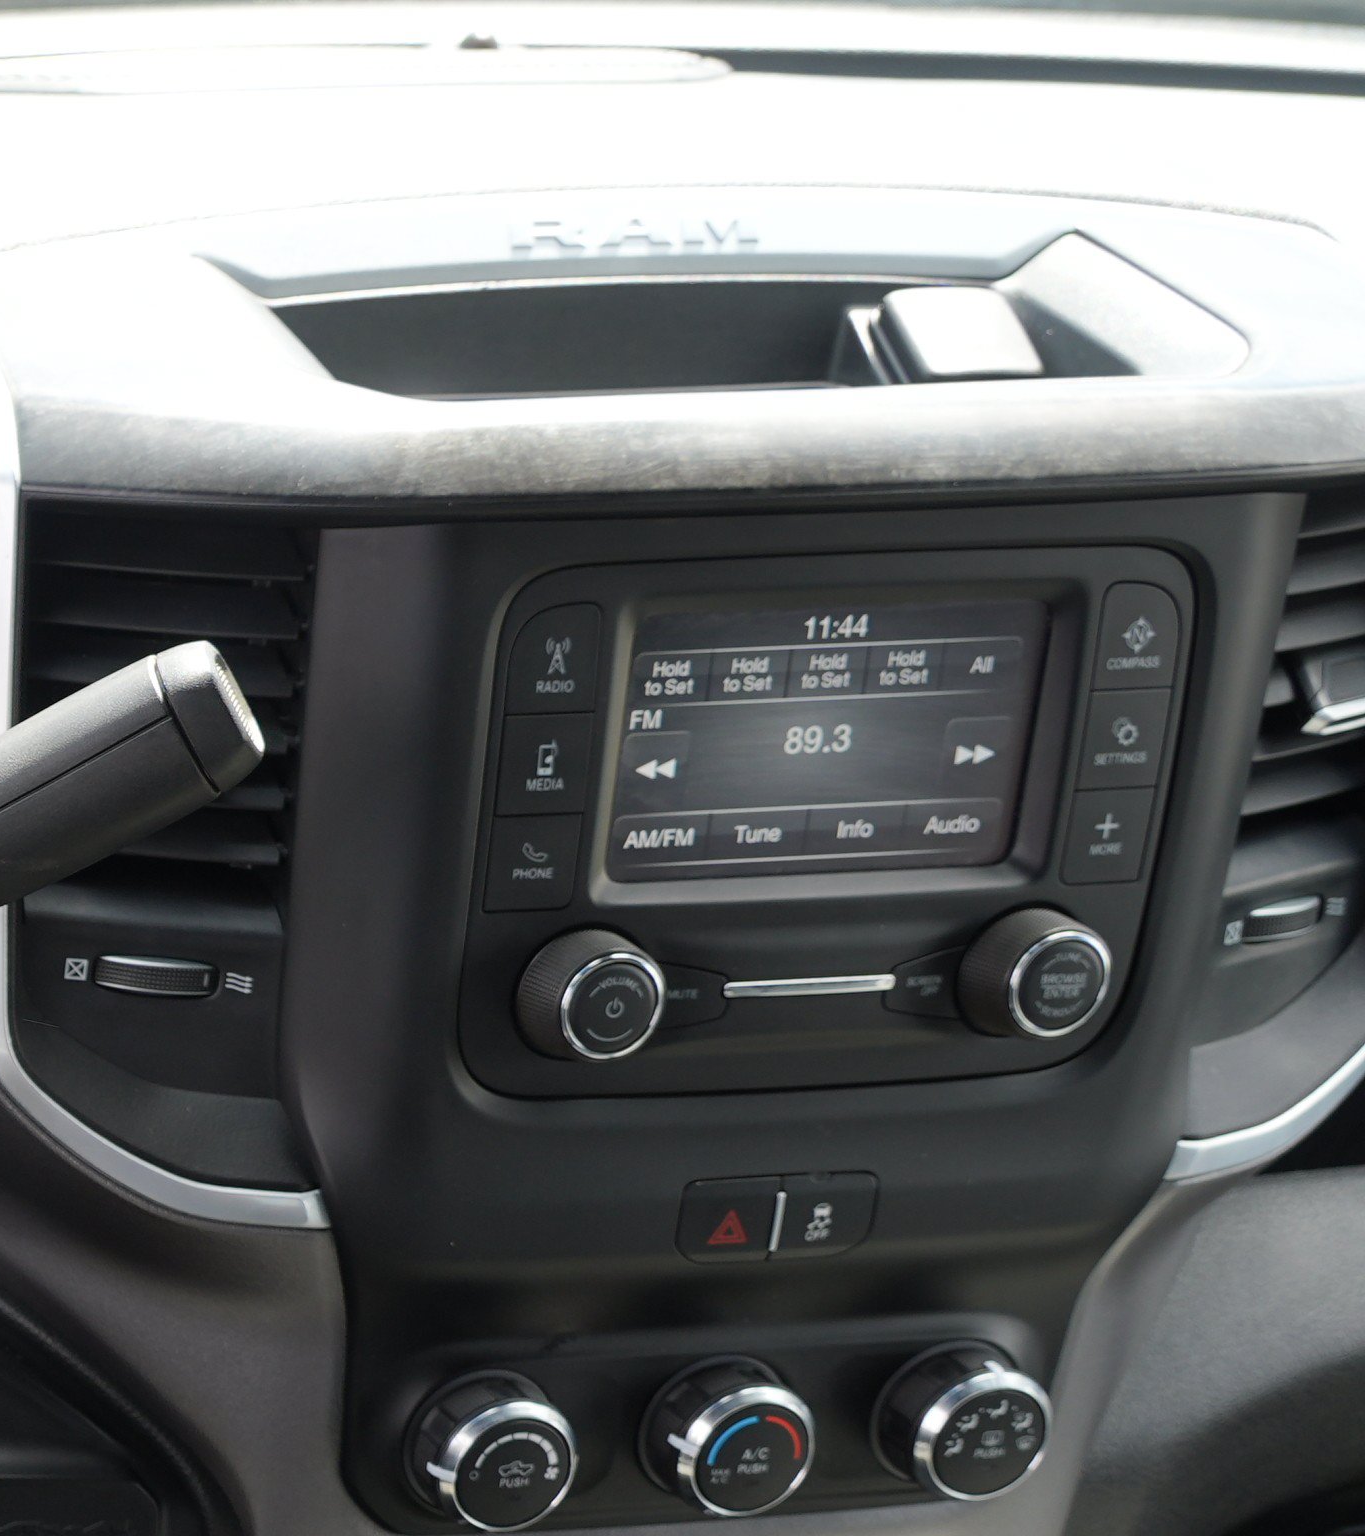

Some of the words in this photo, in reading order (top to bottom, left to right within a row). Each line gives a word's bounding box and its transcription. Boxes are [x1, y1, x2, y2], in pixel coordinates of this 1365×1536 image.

[510, 218, 759, 256] RAM
[804, 613, 869, 641] 11:44
[730, 655, 771, 675] Hold
[809, 652, 849, 671] Hold
[887, 649, 927, 668] Hold
[969, 655, 996, 675] All
[1106, 655, 1161, 671] COMPASS
[652, 659, 692, 679] Hold
[879, 669, 898, 687] to
[898, 667, 930, 686] Set
[535, 679, 576, 694] RADIO
[644, 680, 663, 697] to
[664, 677, 695, 696] Set
[722, 676, 741, 694] to
[742, 674, 773, 692] Set
[801, 672, 819, 690] to
[820, 670, 851, 689] Set
[629, 708, 664, 731] FM
[783, 722, 852, 756] 89.3
[525, 777, 565, 792] MEDIA
[733, 824, 782, 844] Tune
[836, 818, 875, 840] Info
[923, 813, 981, 836] Audio
[622, 827, 696, 850] AM/FM
[512, 866, 555, 880] PHONE
[741, 1446, 770, 1461] A/C
[498, 1477, 530, 1489] PUSH
